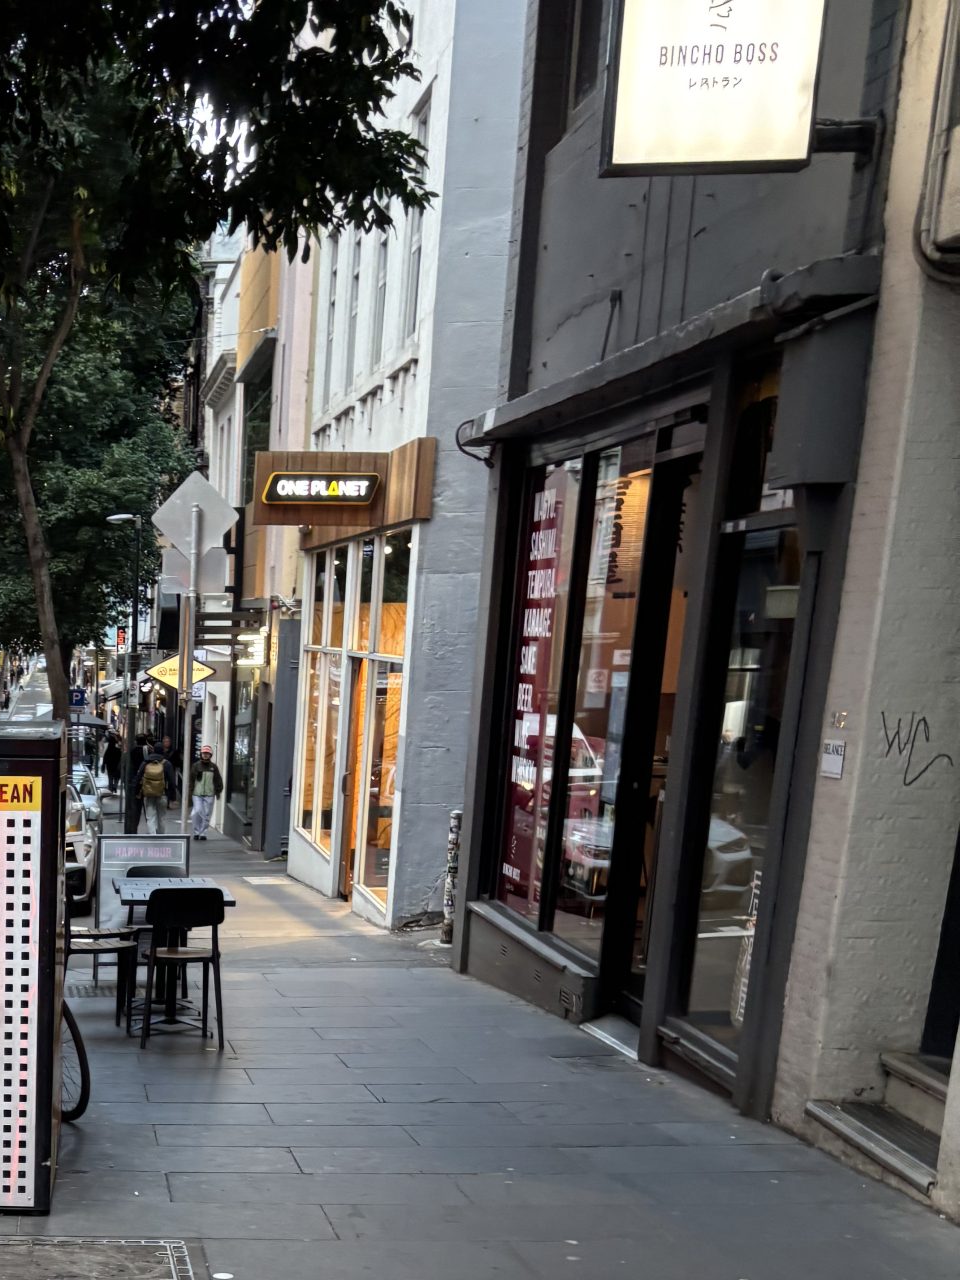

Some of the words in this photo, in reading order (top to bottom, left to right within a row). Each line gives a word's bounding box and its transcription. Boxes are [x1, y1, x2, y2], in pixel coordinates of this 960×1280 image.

[658, 43, 725, 67] BINCHO
[733, 41, 779, 64] BOSS
[688, 76, 742, 90] レストラン
[276, 480, 309, 497] ONE
[310, 480, 369, 497] PLANET
[72, 692, 81, 704] P
[115, 847, 144, 858] HAPPY
[147, 847, 172, 858] HOUR
